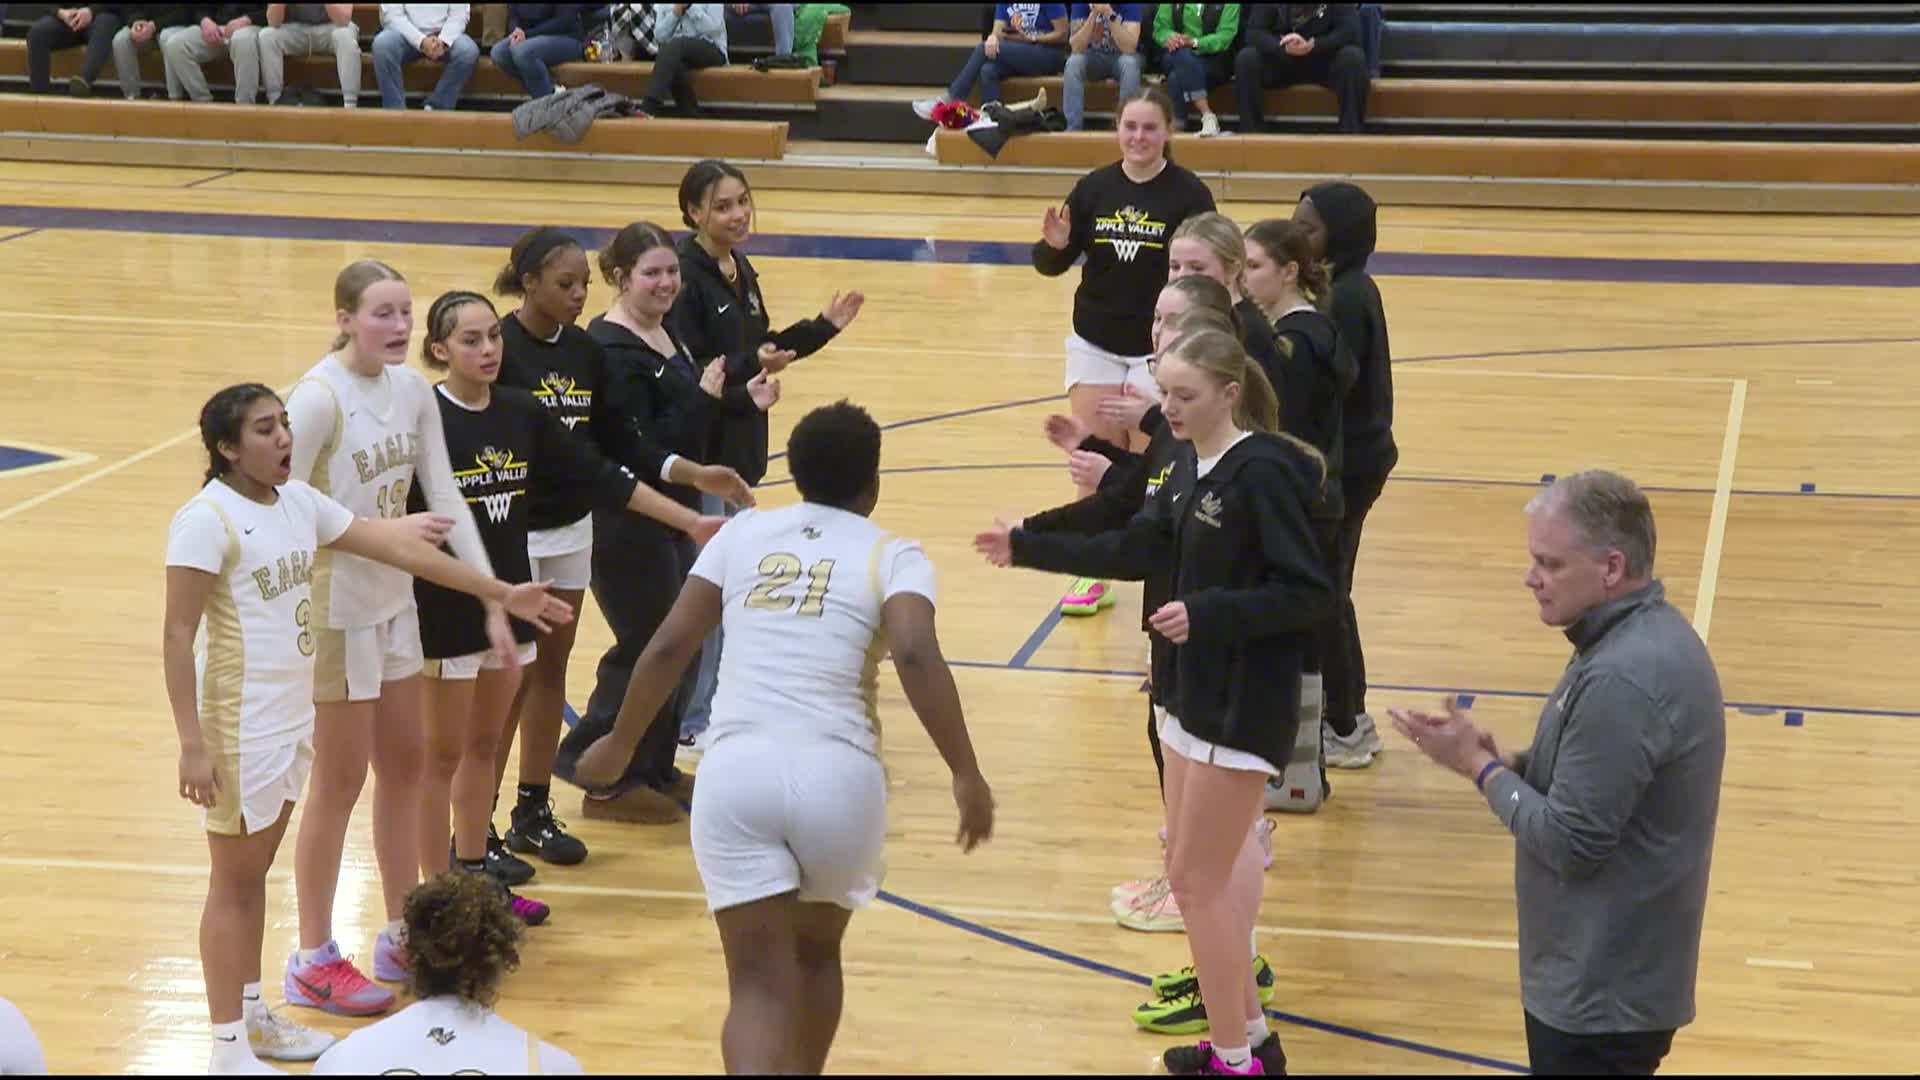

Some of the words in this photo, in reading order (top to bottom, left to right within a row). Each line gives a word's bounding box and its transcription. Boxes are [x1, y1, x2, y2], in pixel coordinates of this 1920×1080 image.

[1096, 221, 1125, 234] APPLE
[1128, 223, 1165, 237] VALLEY
[456, 471, 494, 489] APPLE
[744, 552, 836, 617] 21
[295, 598, 315, 656] 3
